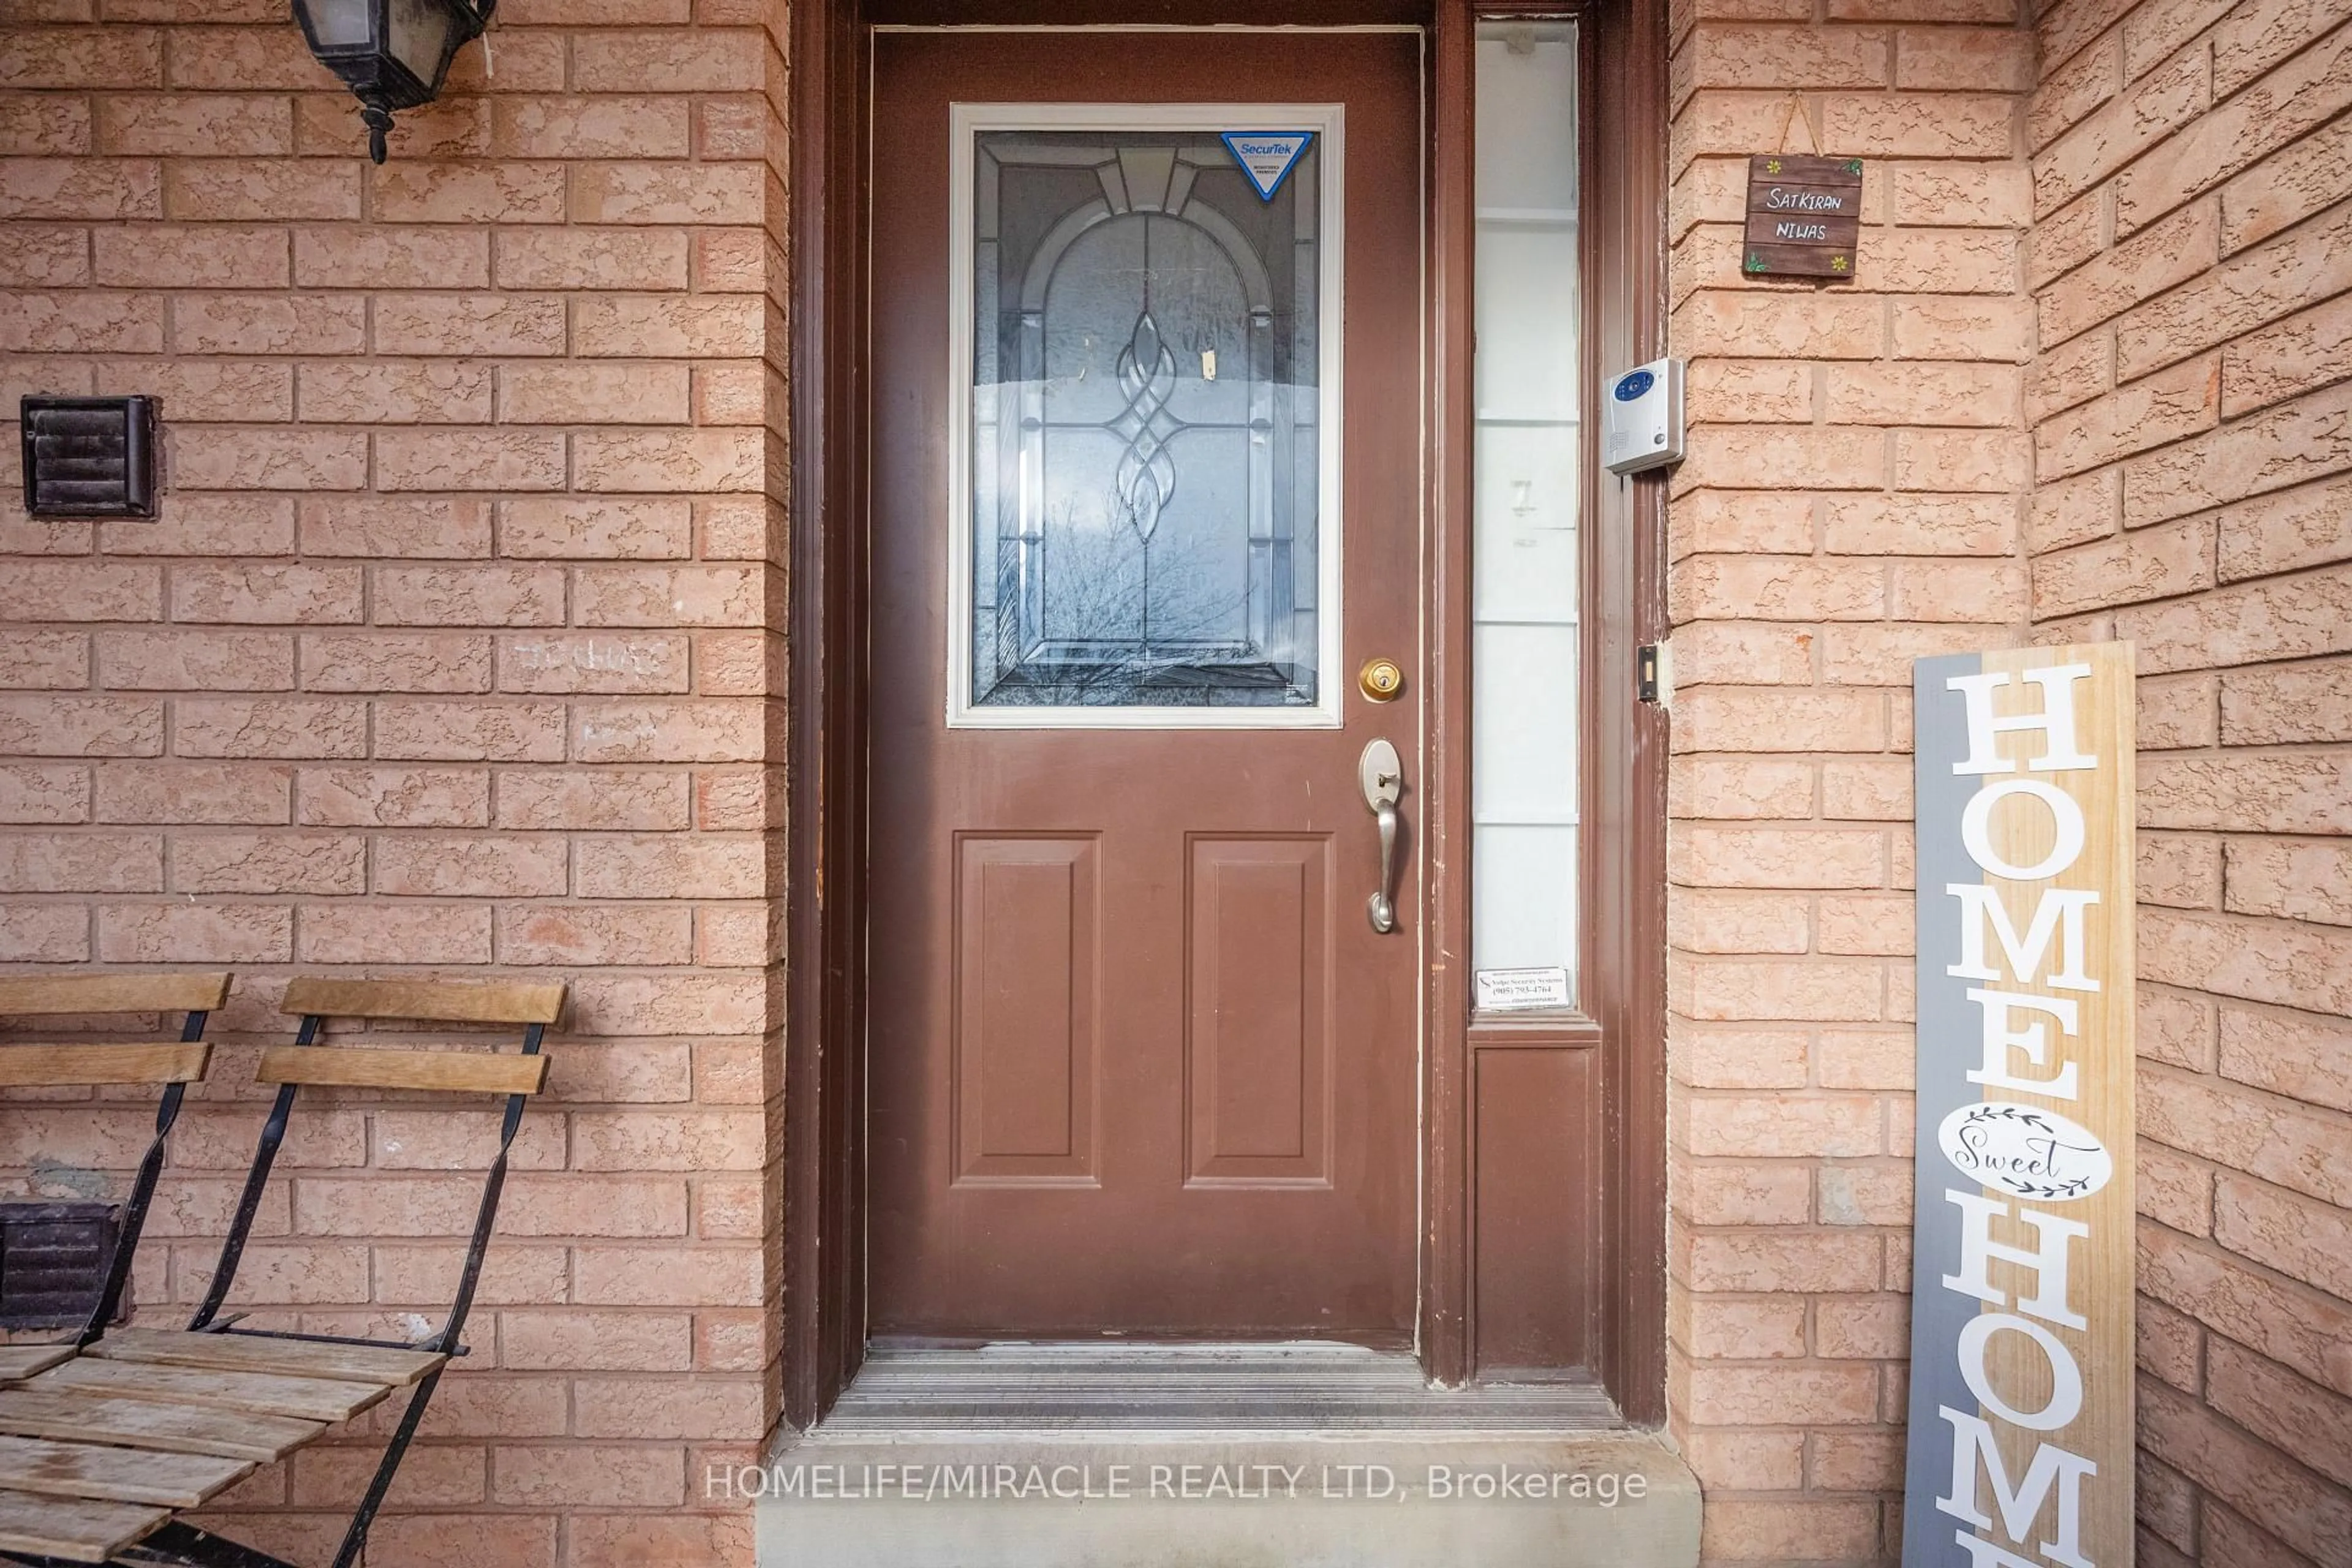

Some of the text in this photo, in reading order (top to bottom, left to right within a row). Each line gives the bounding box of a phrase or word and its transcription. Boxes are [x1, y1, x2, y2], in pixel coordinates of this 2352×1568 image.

[1241, 143, 1292, 154] SecurTek
[1766, 187, 1842, 210] SATKIRAN
[1776, 222, 1826, 239] NIWAS
[1946, 663, 2100, 1101] HOME
[1493, 987, 1515, 997] (905)
[1955, 1125, 2101, 1178] Sweet
